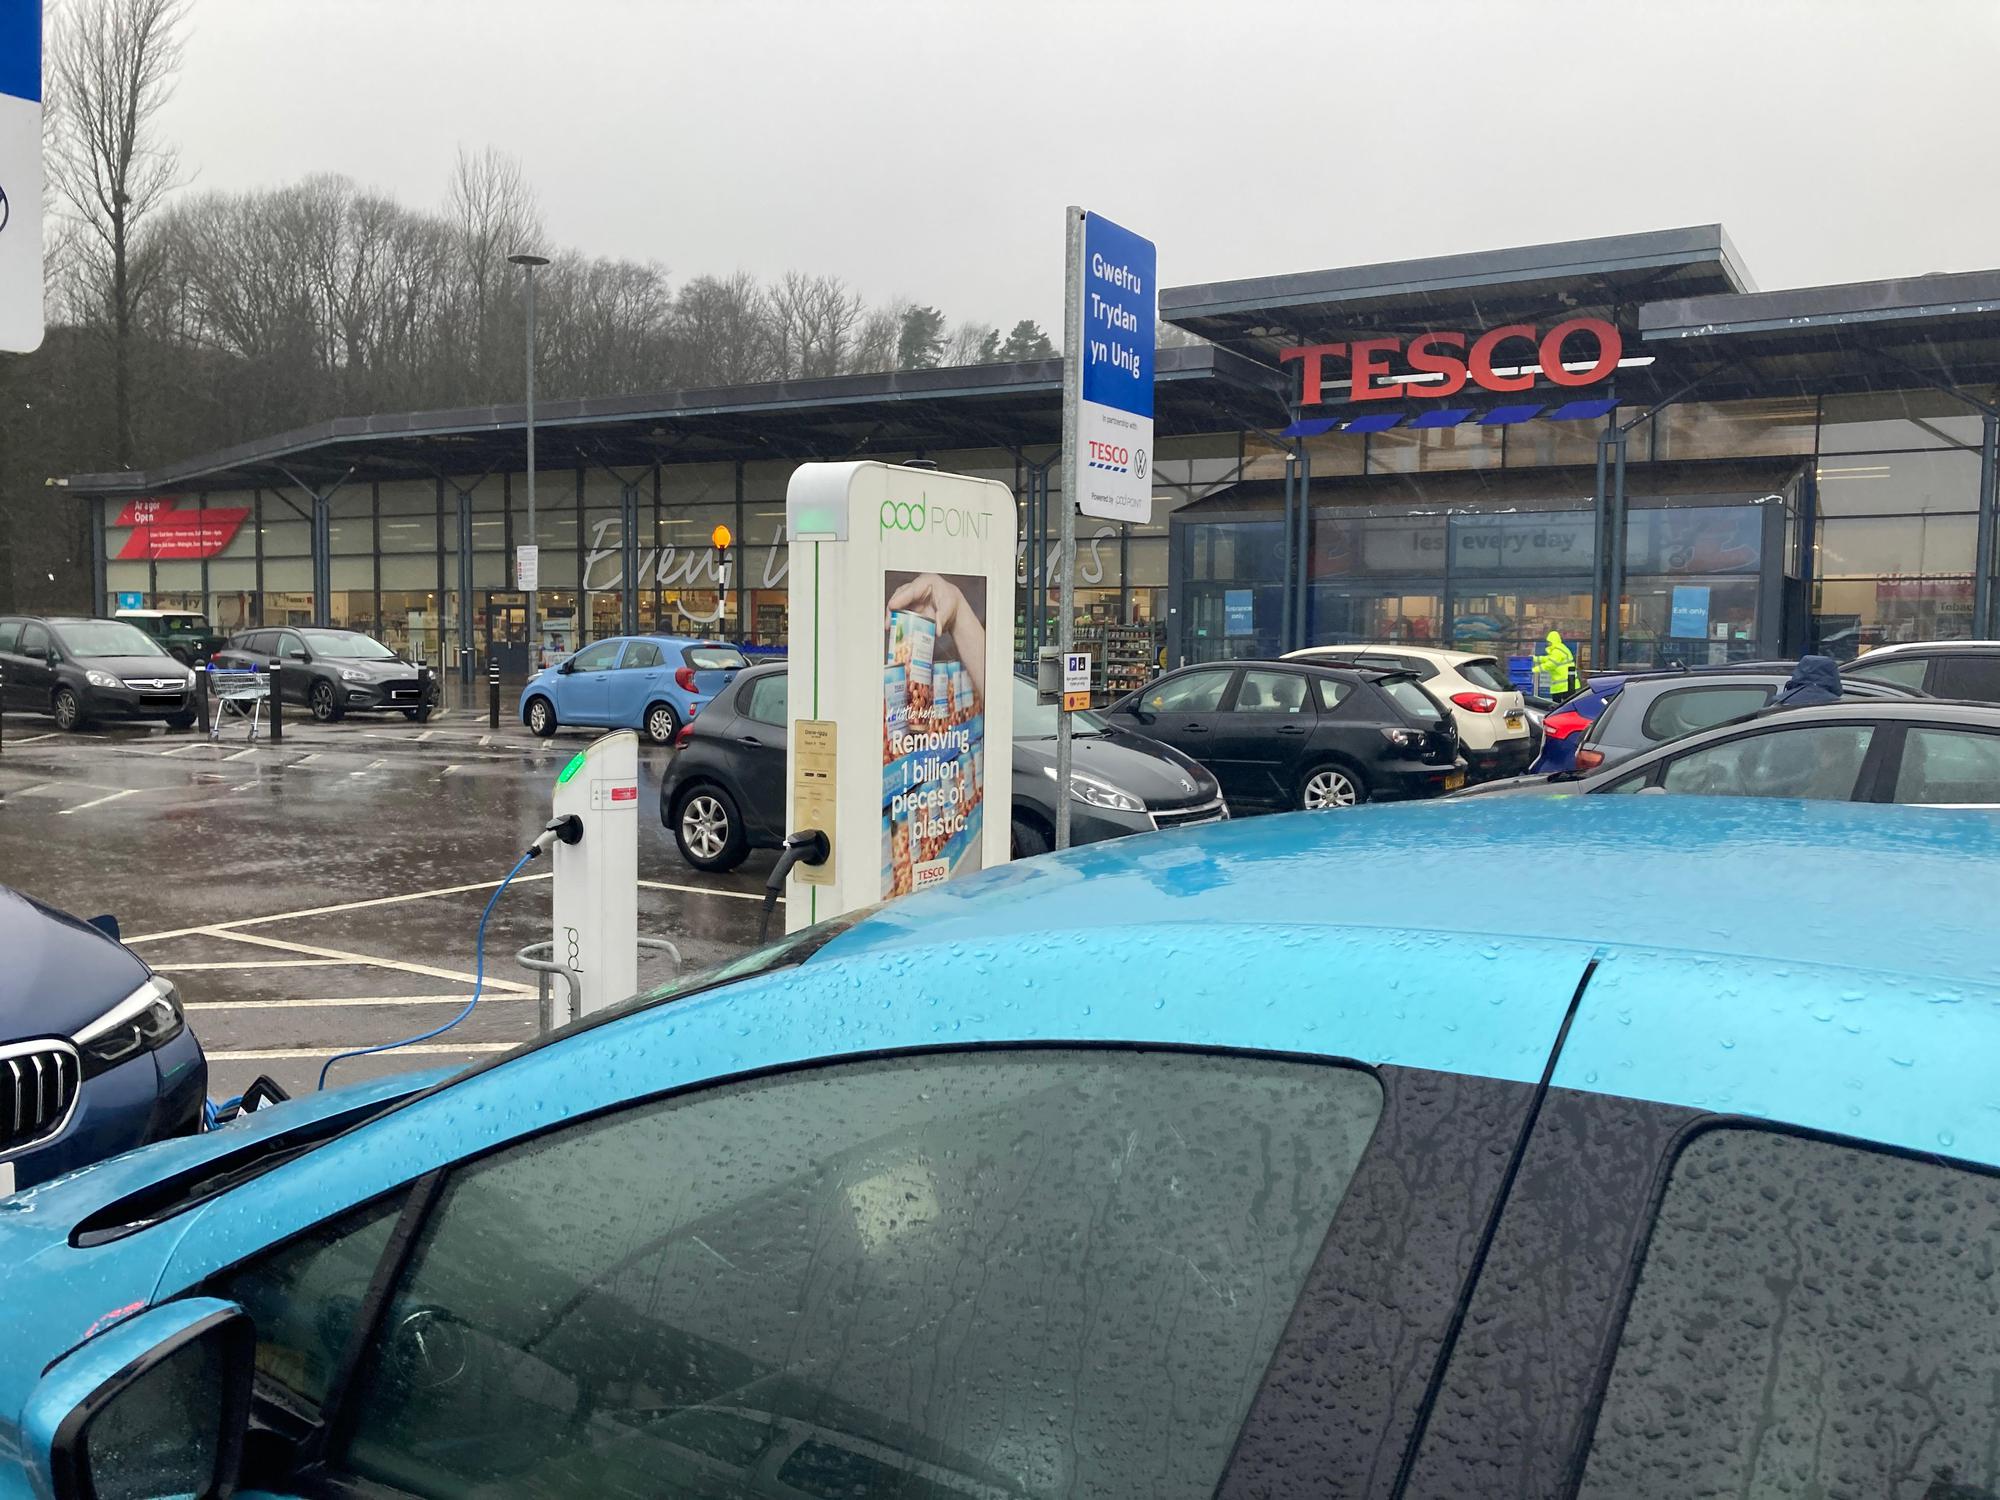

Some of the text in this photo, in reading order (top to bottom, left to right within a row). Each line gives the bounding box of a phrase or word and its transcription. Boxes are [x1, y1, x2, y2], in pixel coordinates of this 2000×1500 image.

[1092, 253, 1141, 295] Gwefru
[1091, 293, 1137, 333] Trydan
[1090, 340, 1140, 379] yn Unig
[1280, 318, 1622, 405] TESCO
[1089, 441, 1129, 465] TESCO
[134, 512, 154, 524] Open
[880, 490, 993, 544] pod POINT
[1412, 528, 1577, 553] les every day
[891, 725, 970, 755] Removing
[901, 760, 909, 784] 1
[913, 756, 960, 784] billion
[891, 781, 966, 821] pieces of
[911, 810, 968, 847] plastic.
[917, 866, 945, 881] TESCO
